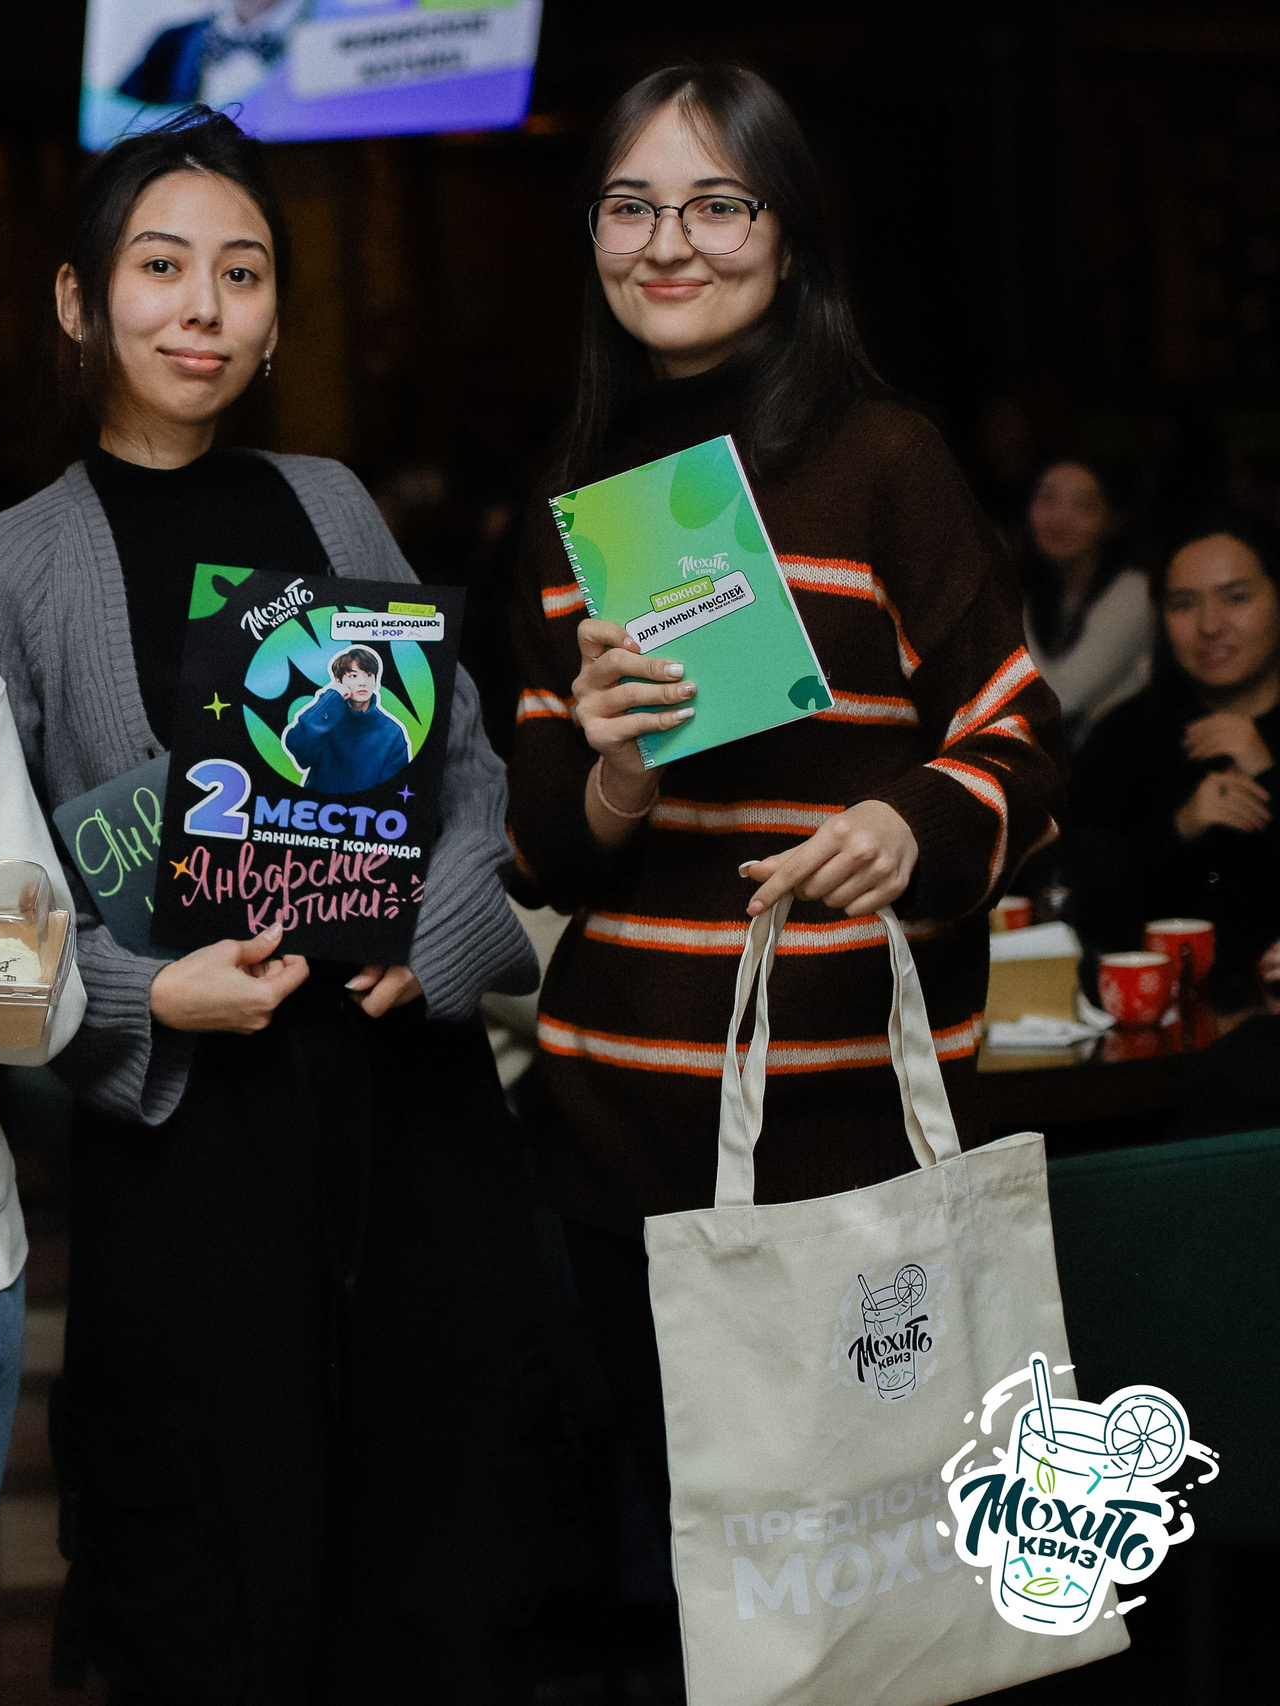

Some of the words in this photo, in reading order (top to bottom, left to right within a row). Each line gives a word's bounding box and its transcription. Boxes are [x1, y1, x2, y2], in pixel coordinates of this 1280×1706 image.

[654, 581, 709, 608] БЛОКНОТ
[270, 606, 300, 628] КВИЗ
[335, 618, 379, 629] УГАДАЙ
[381, 619, 441, 628] МЕЛОДИЮ:
[637, 625, 659, 642] ДЛЯ
[658, 607, 698, 631] УМНЫХ
[698, 584, 744, 613] МЫСЛЕЙ
[184, 758, 252, 840] 2
[253, 795, 408, 840] МЕСТО
[252, 829, 340, 850] ЗАНИМАЕТ
[342, 839, 421, 860] КОМАНДА
[181, 841, 390, 907] Январские
[878, 1352, 911, 1371] КВИЗ
[723, 1468, 952, 1547] ПРЕДПОЧ
